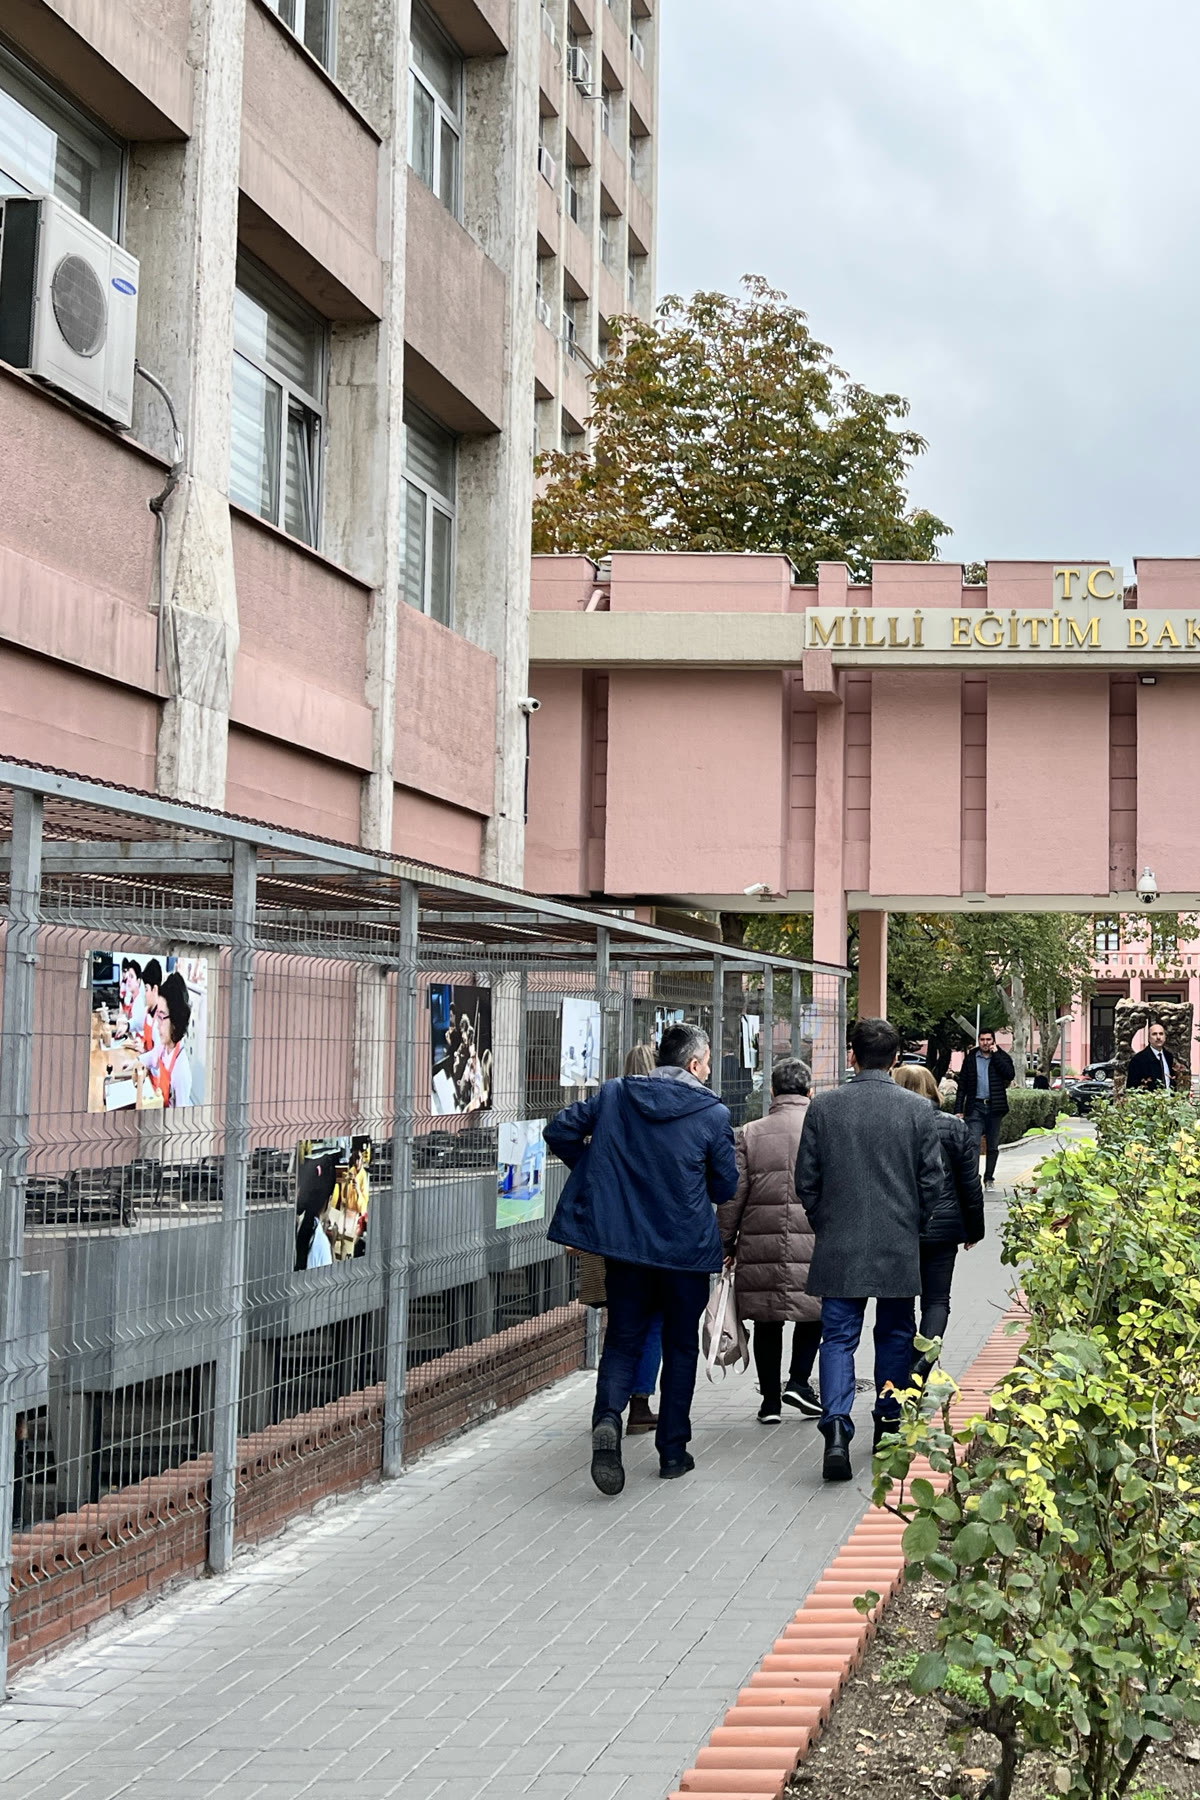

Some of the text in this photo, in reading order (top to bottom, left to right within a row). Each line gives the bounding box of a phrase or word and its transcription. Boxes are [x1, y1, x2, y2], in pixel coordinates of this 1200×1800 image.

[1055, 568, 1123, 600] T.C.
[809, 608, 925, 647] MİLLİ
[951, 609, 1102, 648] EĞİTİM
